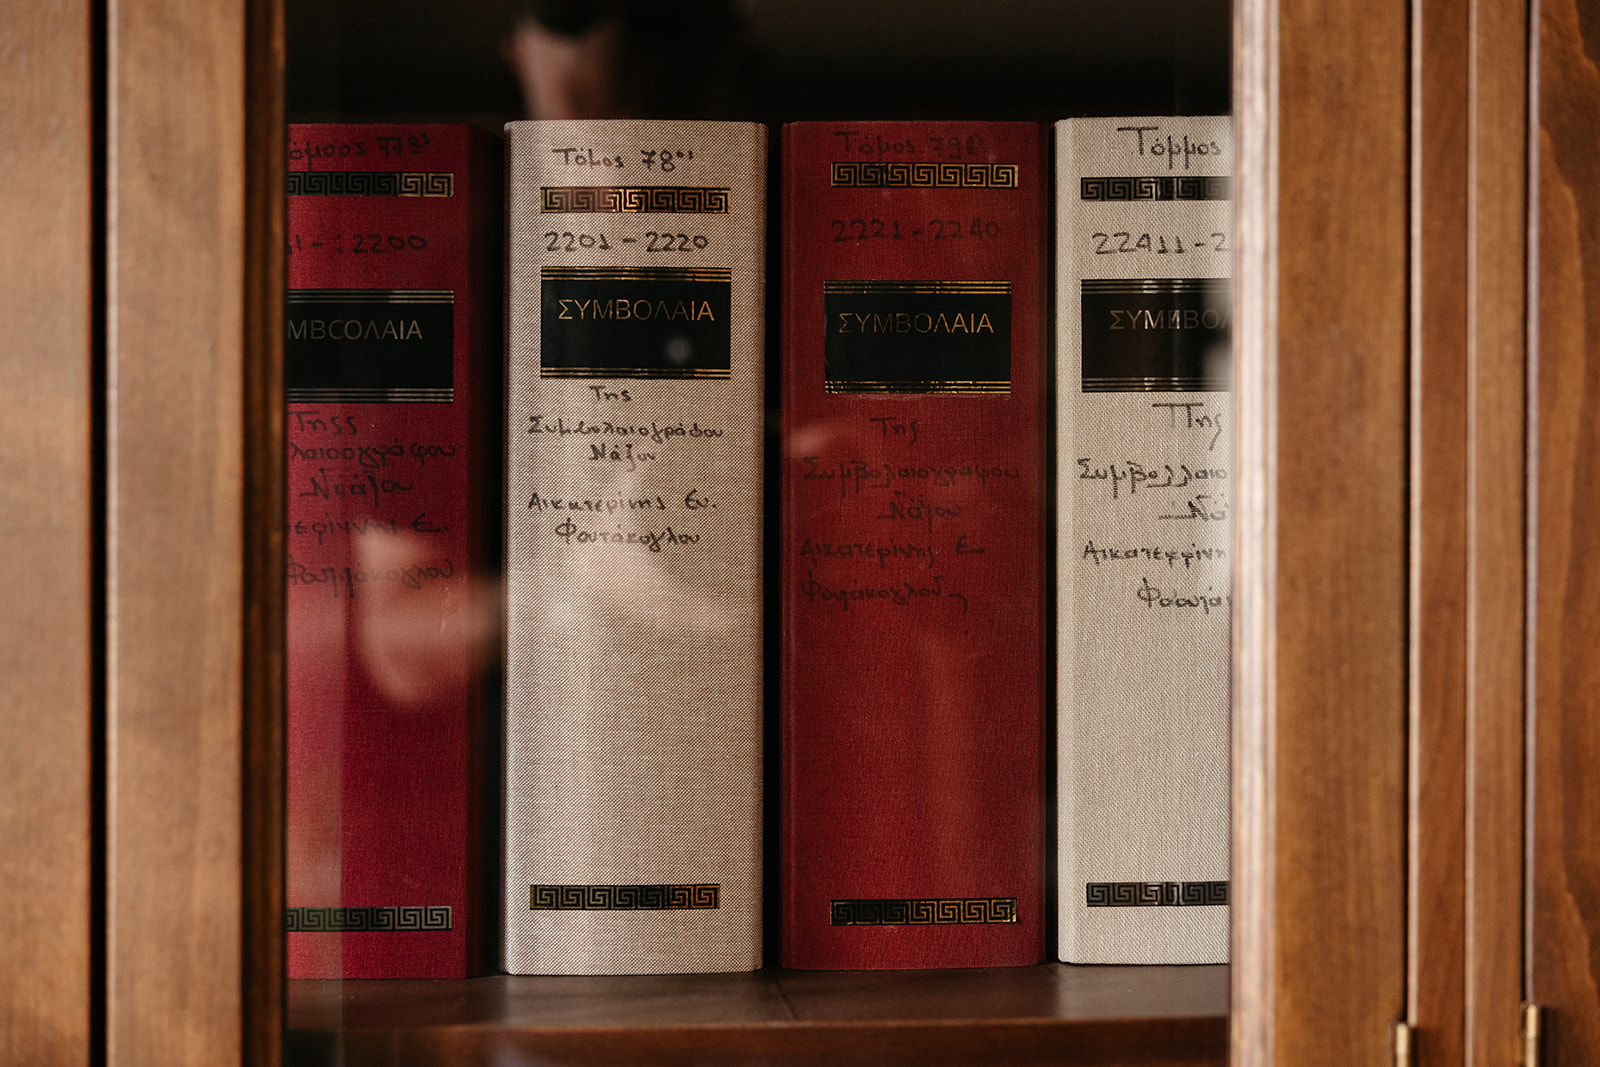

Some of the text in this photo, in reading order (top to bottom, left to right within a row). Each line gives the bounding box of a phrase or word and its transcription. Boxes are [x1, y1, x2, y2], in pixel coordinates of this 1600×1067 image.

[551, 148, 624, 168] Τόμος
[645, 231, 709, 252] 2220
[558, 299, 715, 321] ΣΥΜΒΟΛΑΙΑ
[838, 312, 994, 334] ΣΥΜΒΟΛΑΙΑ
